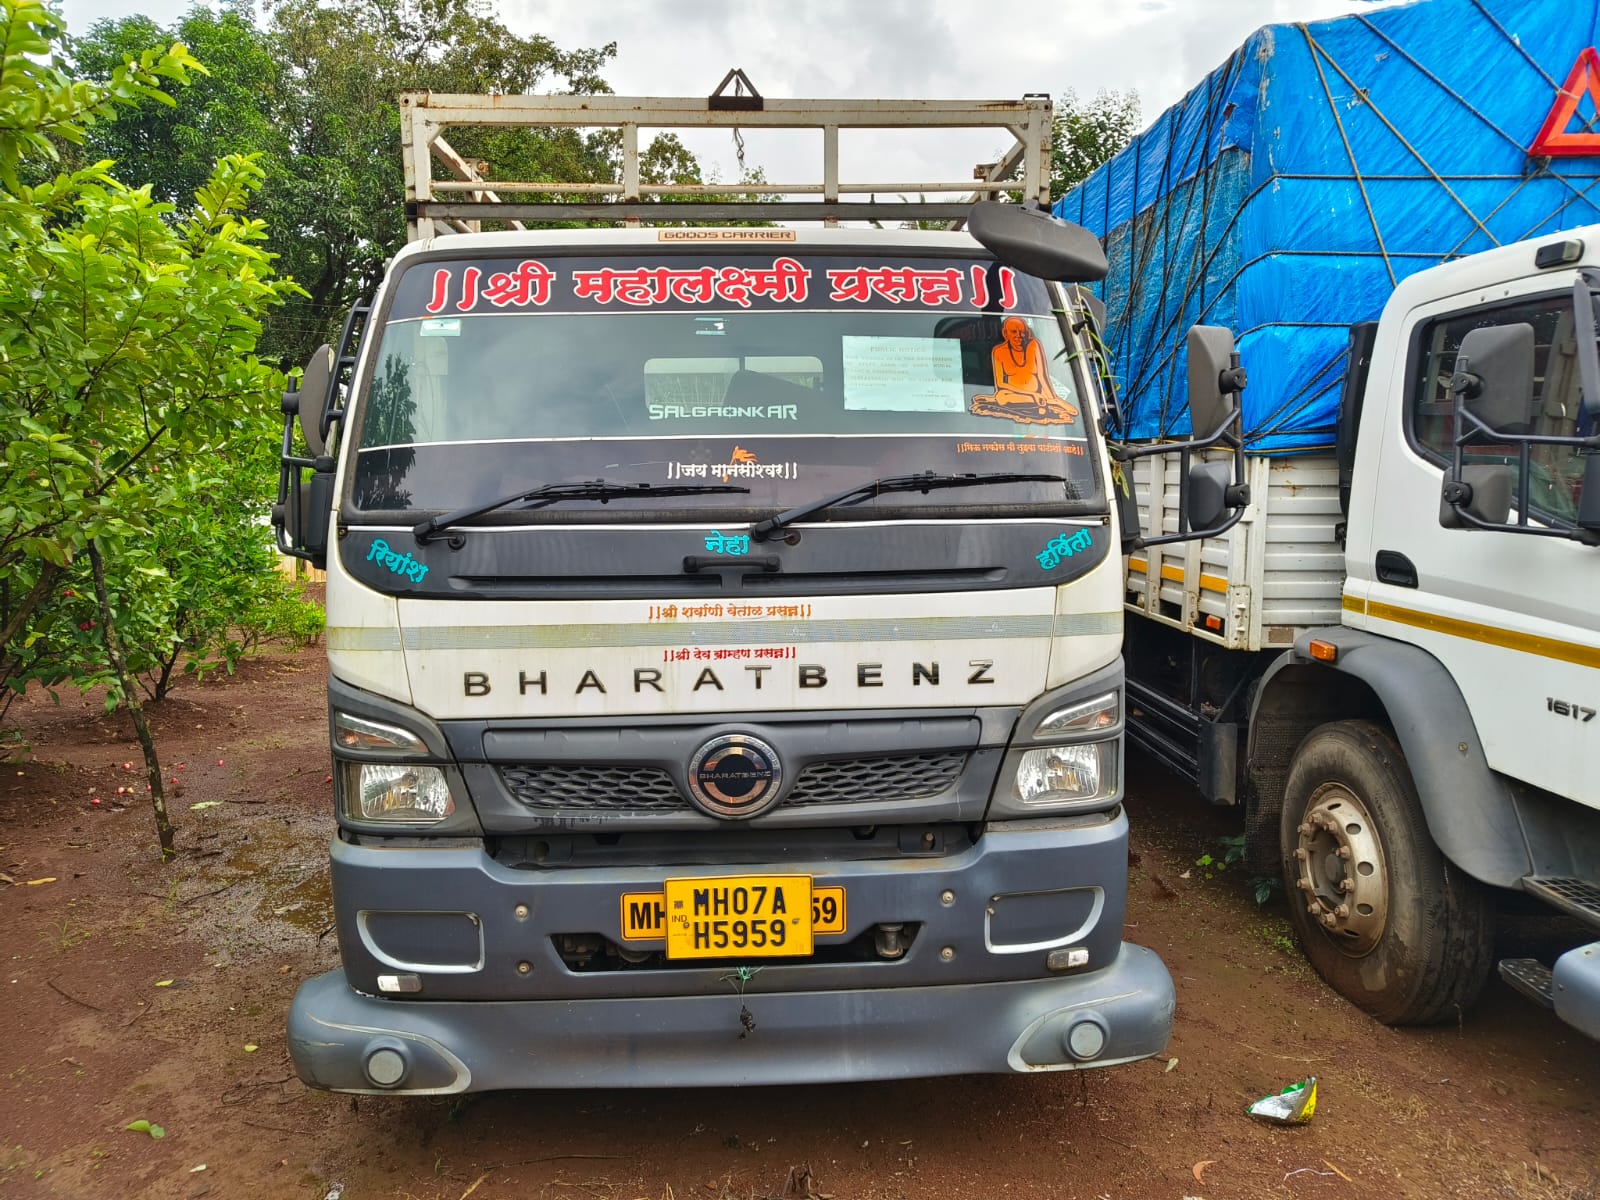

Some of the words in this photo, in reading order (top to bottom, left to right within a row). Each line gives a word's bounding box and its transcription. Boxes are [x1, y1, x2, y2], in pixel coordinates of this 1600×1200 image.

[664, 231, 718, 239] GOODS
[722, 231, 792, 239] CARRIER
[572, 256, 812, 308] महालक्ष्मी
[704, 529, 750, 556] नेहा
[694, 647, 711, 661] देव
[464, 659, 995, 697] BHARATBENZ
[1546, 697, 1597, 722] 1617
[693, 886, 787, 917] MH07A
[671, 914, 688, 923] IND
[693, 919, 786, 950] H5959
